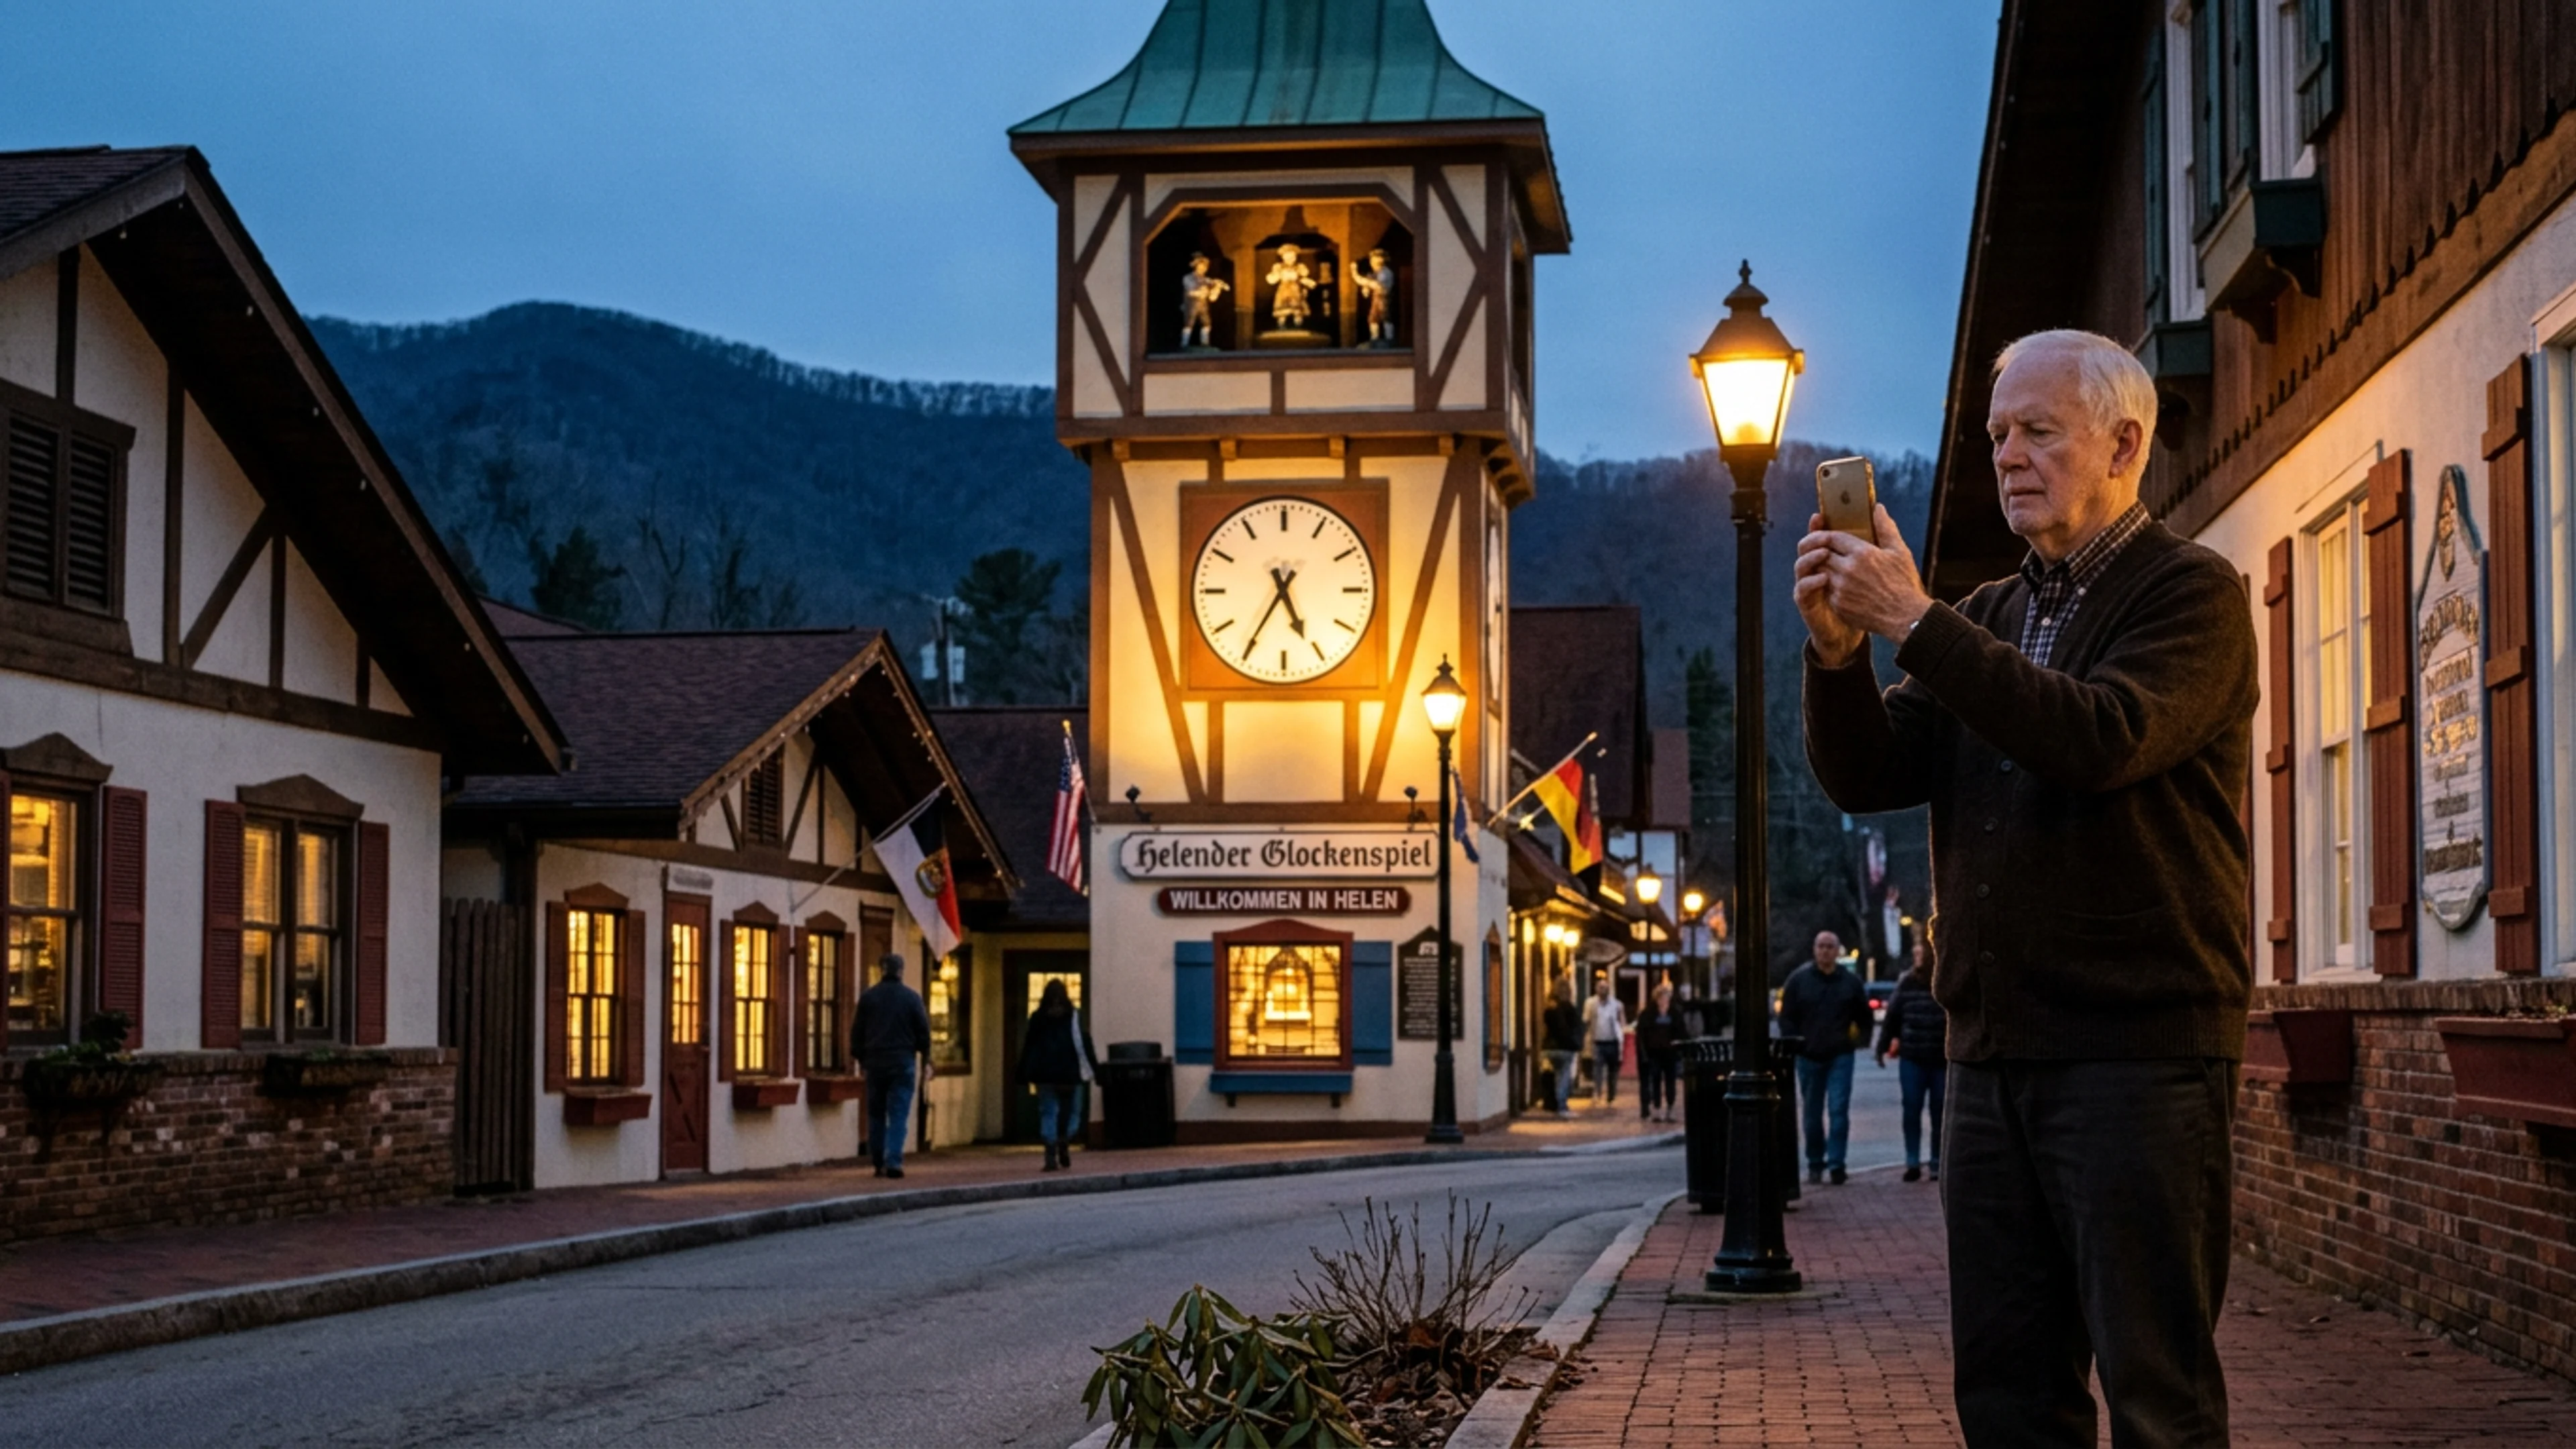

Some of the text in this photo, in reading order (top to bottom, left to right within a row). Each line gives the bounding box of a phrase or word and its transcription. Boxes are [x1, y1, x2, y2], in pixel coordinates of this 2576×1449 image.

[1135, 839, 1431, 873] Helender Glockenspiel
[1170, 890, 1397, 910] WILLKOMMEN IN HELEN
